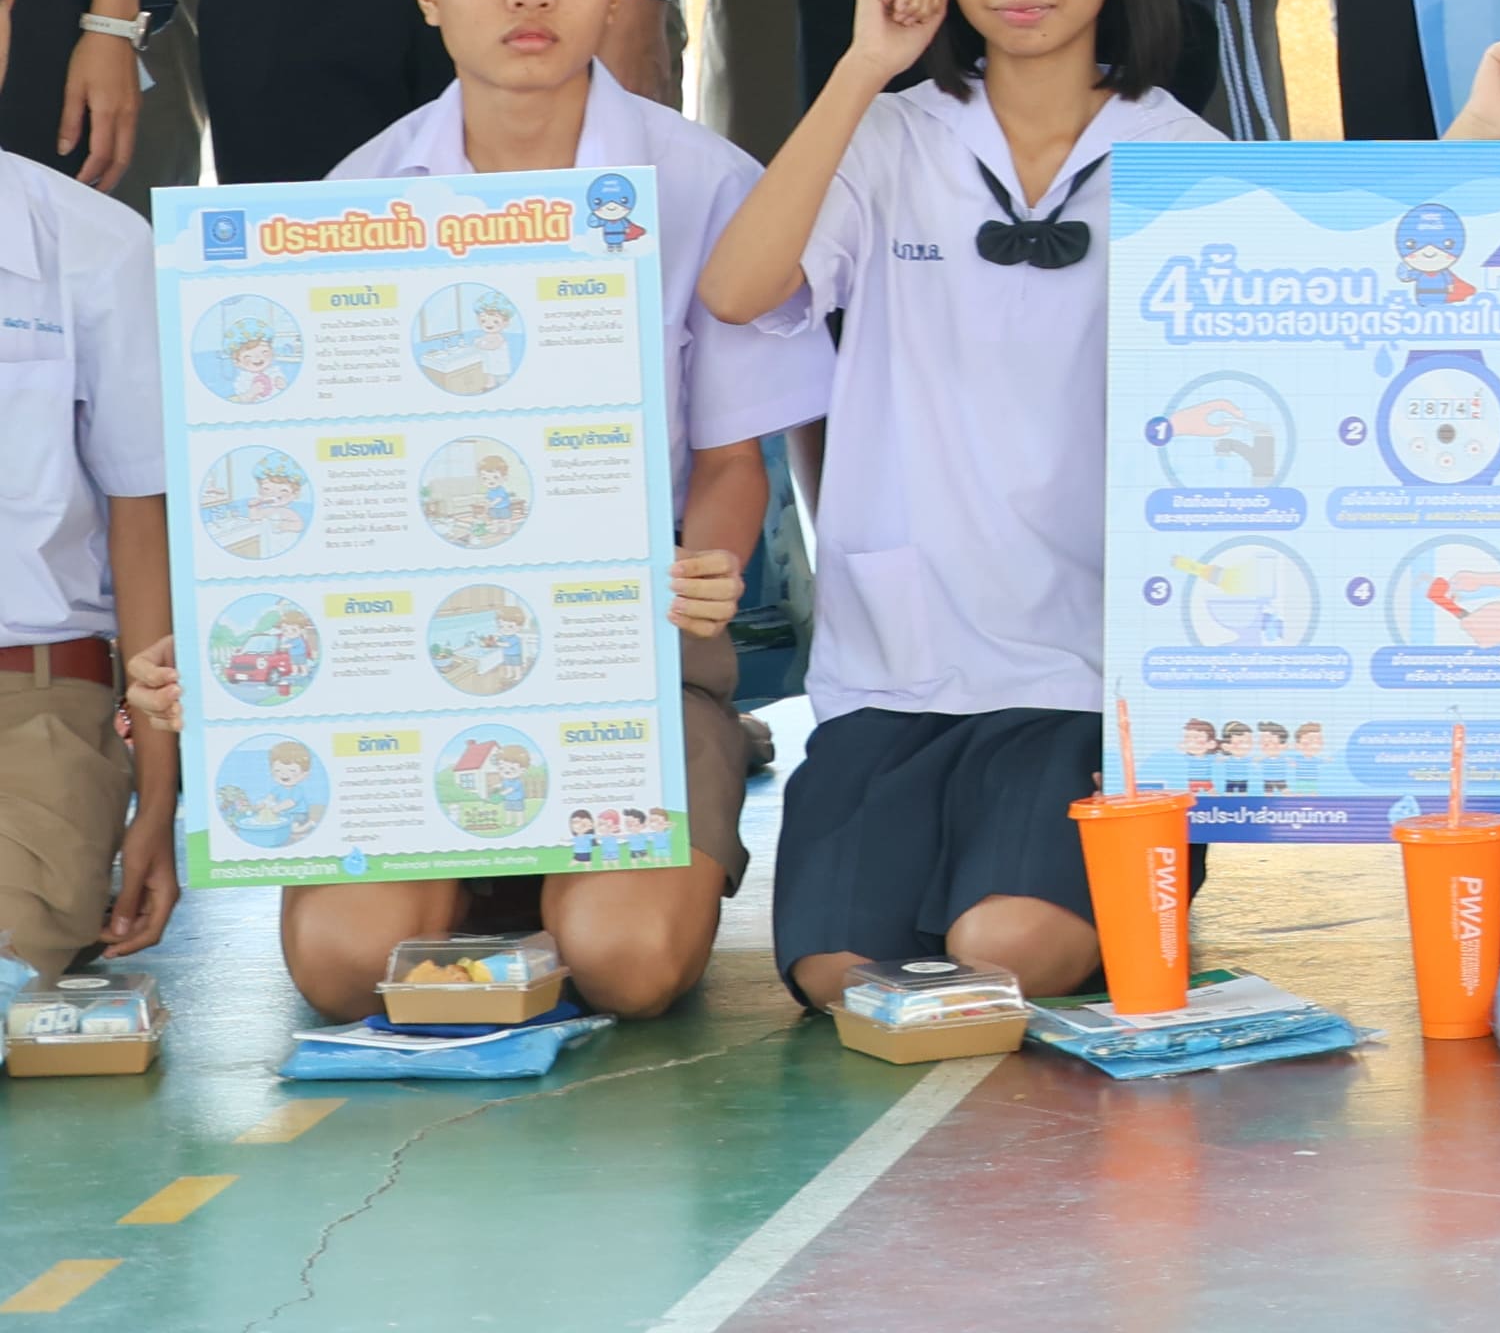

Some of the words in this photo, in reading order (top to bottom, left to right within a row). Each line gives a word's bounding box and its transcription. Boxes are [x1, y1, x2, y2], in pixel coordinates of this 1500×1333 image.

[260, 203, 423, 256] ประหยัดน้ำ
[440, 199, 572, 256] คุณทำได้
[331, 285, 380, 307] อาบน้ำ
[1202, 252, 1373, 306] ขั้นตอน
[1150, 266, 1194, 337] 4
[345, 597, 393, 617] ล้างรถ
[1150, 582, 1168, 600] 3
[1353, 582, 1371, 600] 4
[1187, 806, 1348, 830] ารประปาส่วนภูมิภาค
[1155, 847, 1177, 911] PWA
[1459, 876, 1482, 941] PWA
